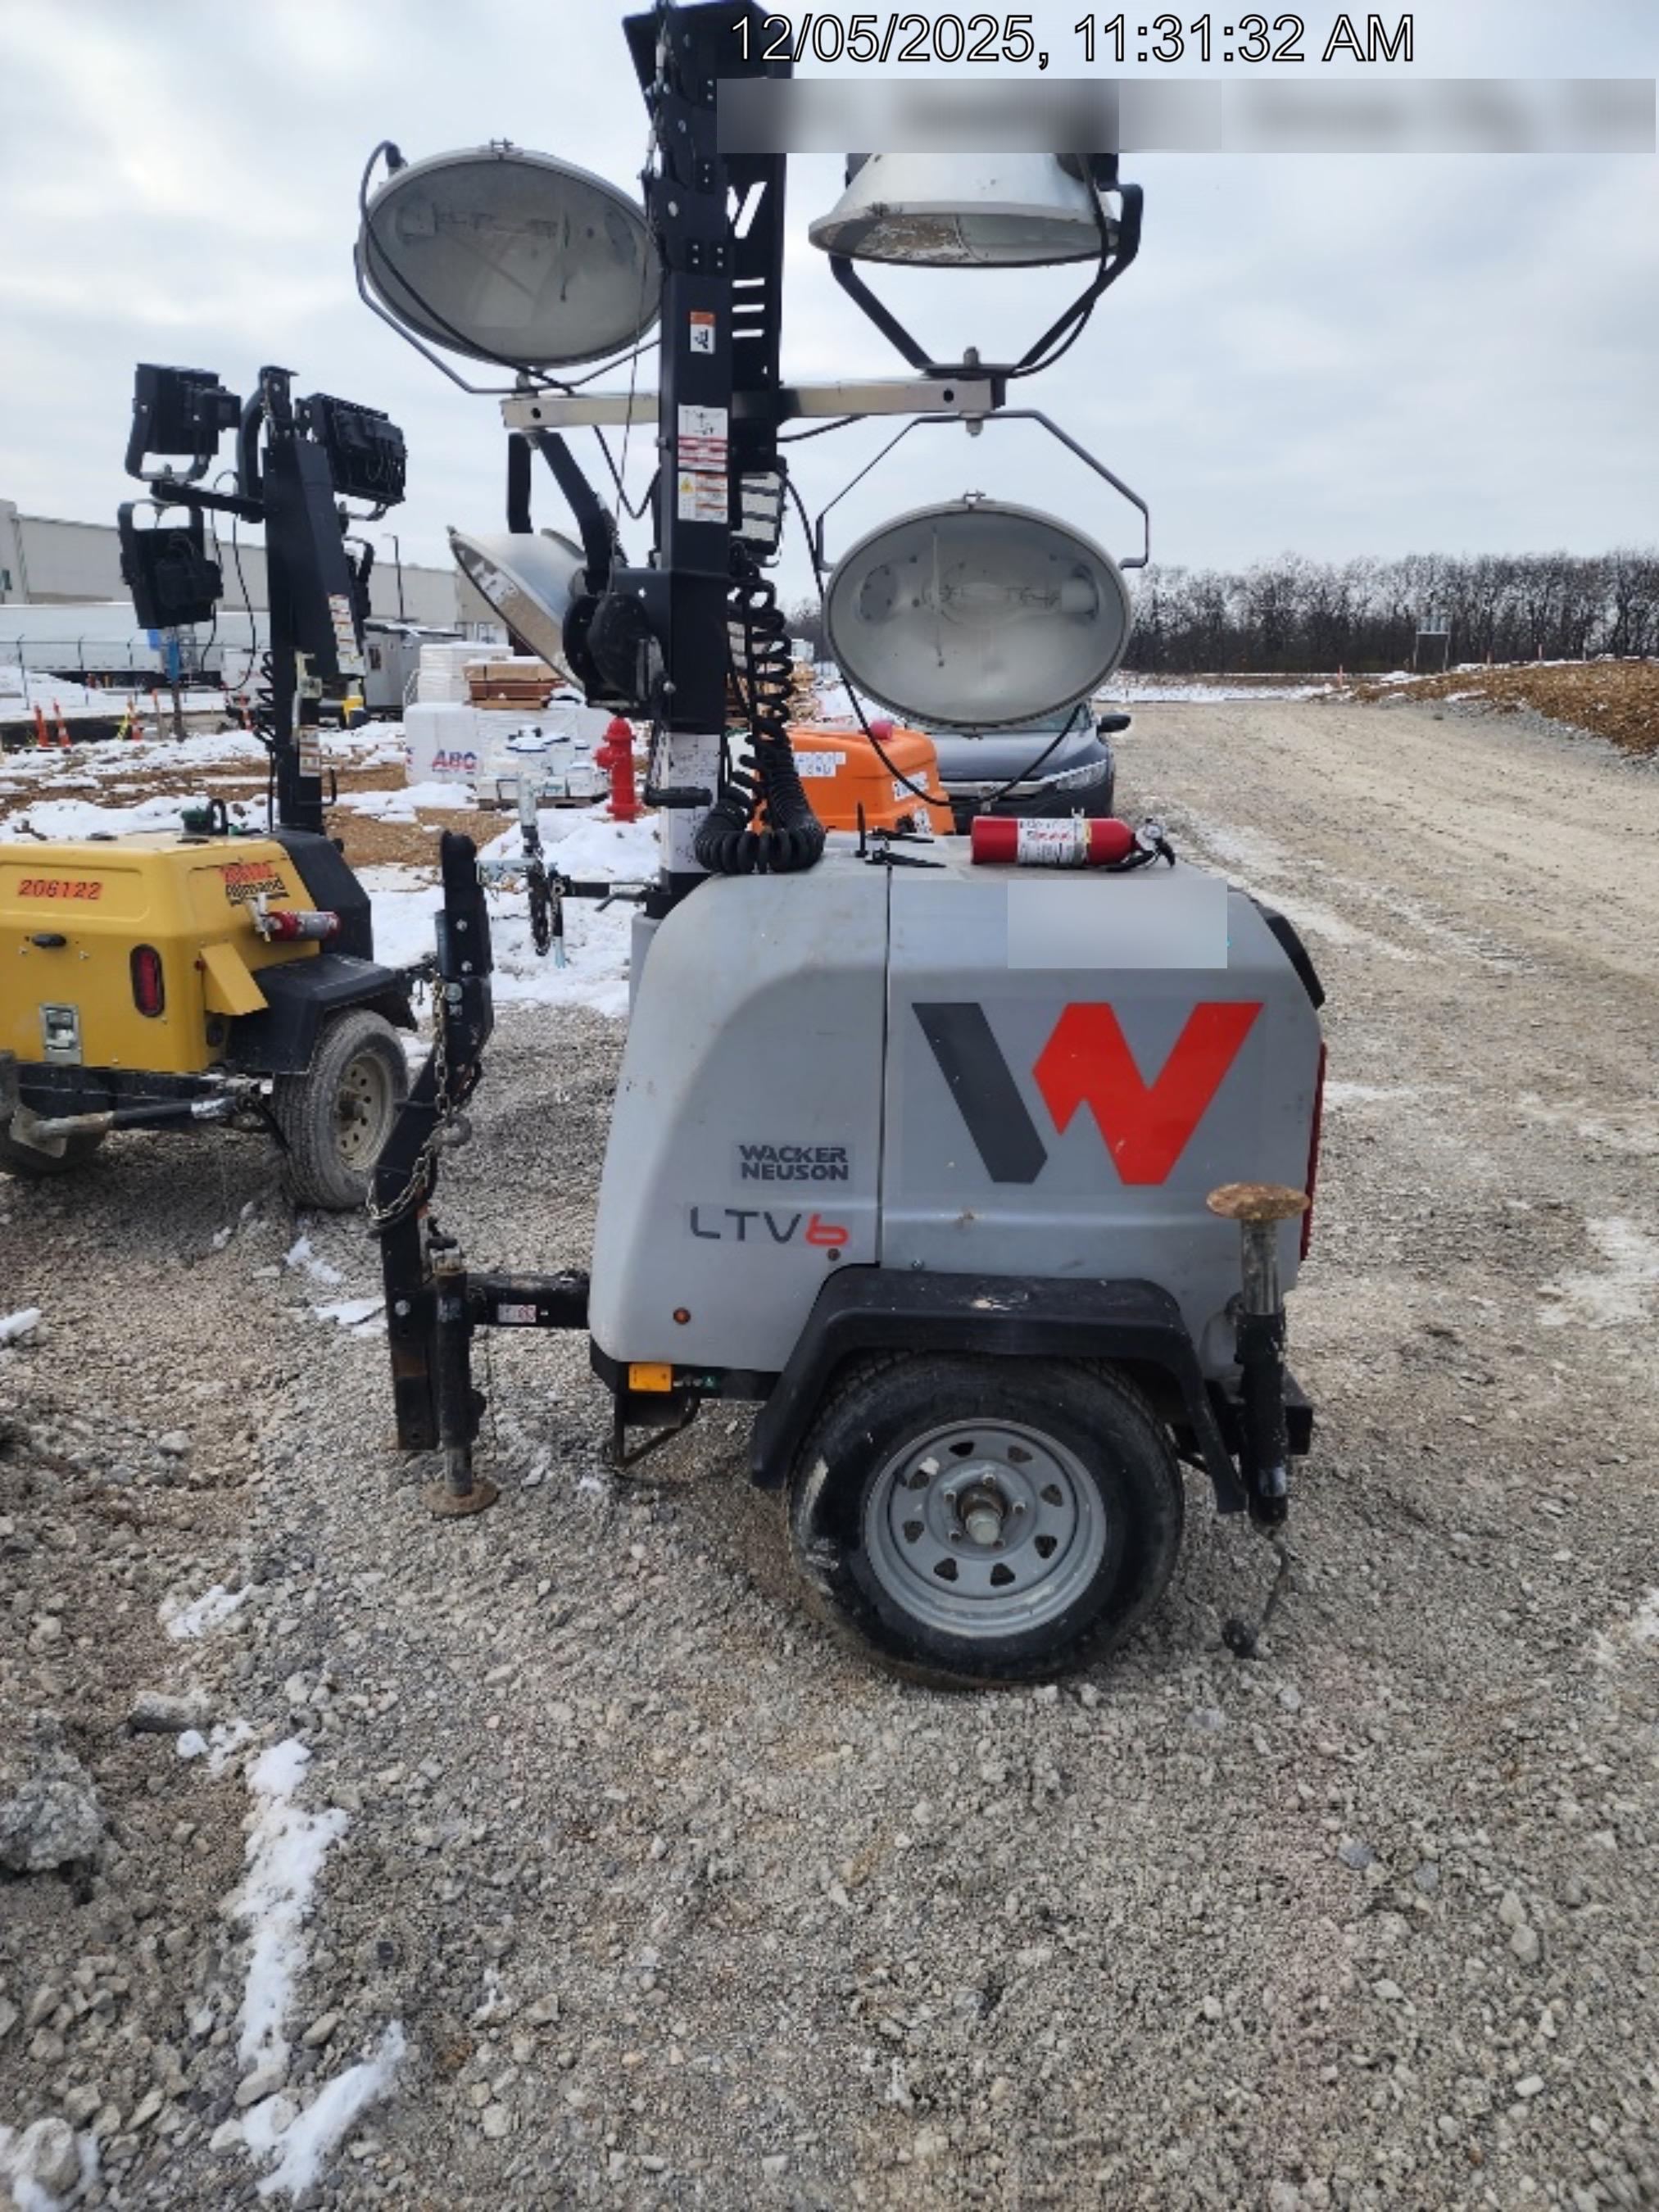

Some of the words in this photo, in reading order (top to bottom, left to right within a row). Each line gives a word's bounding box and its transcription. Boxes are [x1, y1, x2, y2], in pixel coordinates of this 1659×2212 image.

[431, 748, 477, 770] ABC
[18, 878, 102, 900] 206122
[739, 1145, 849, 1163] WACKER
[741, 1162, 849, 1181] NEUSON
[689, 1205, 850, 1247] LTV6
